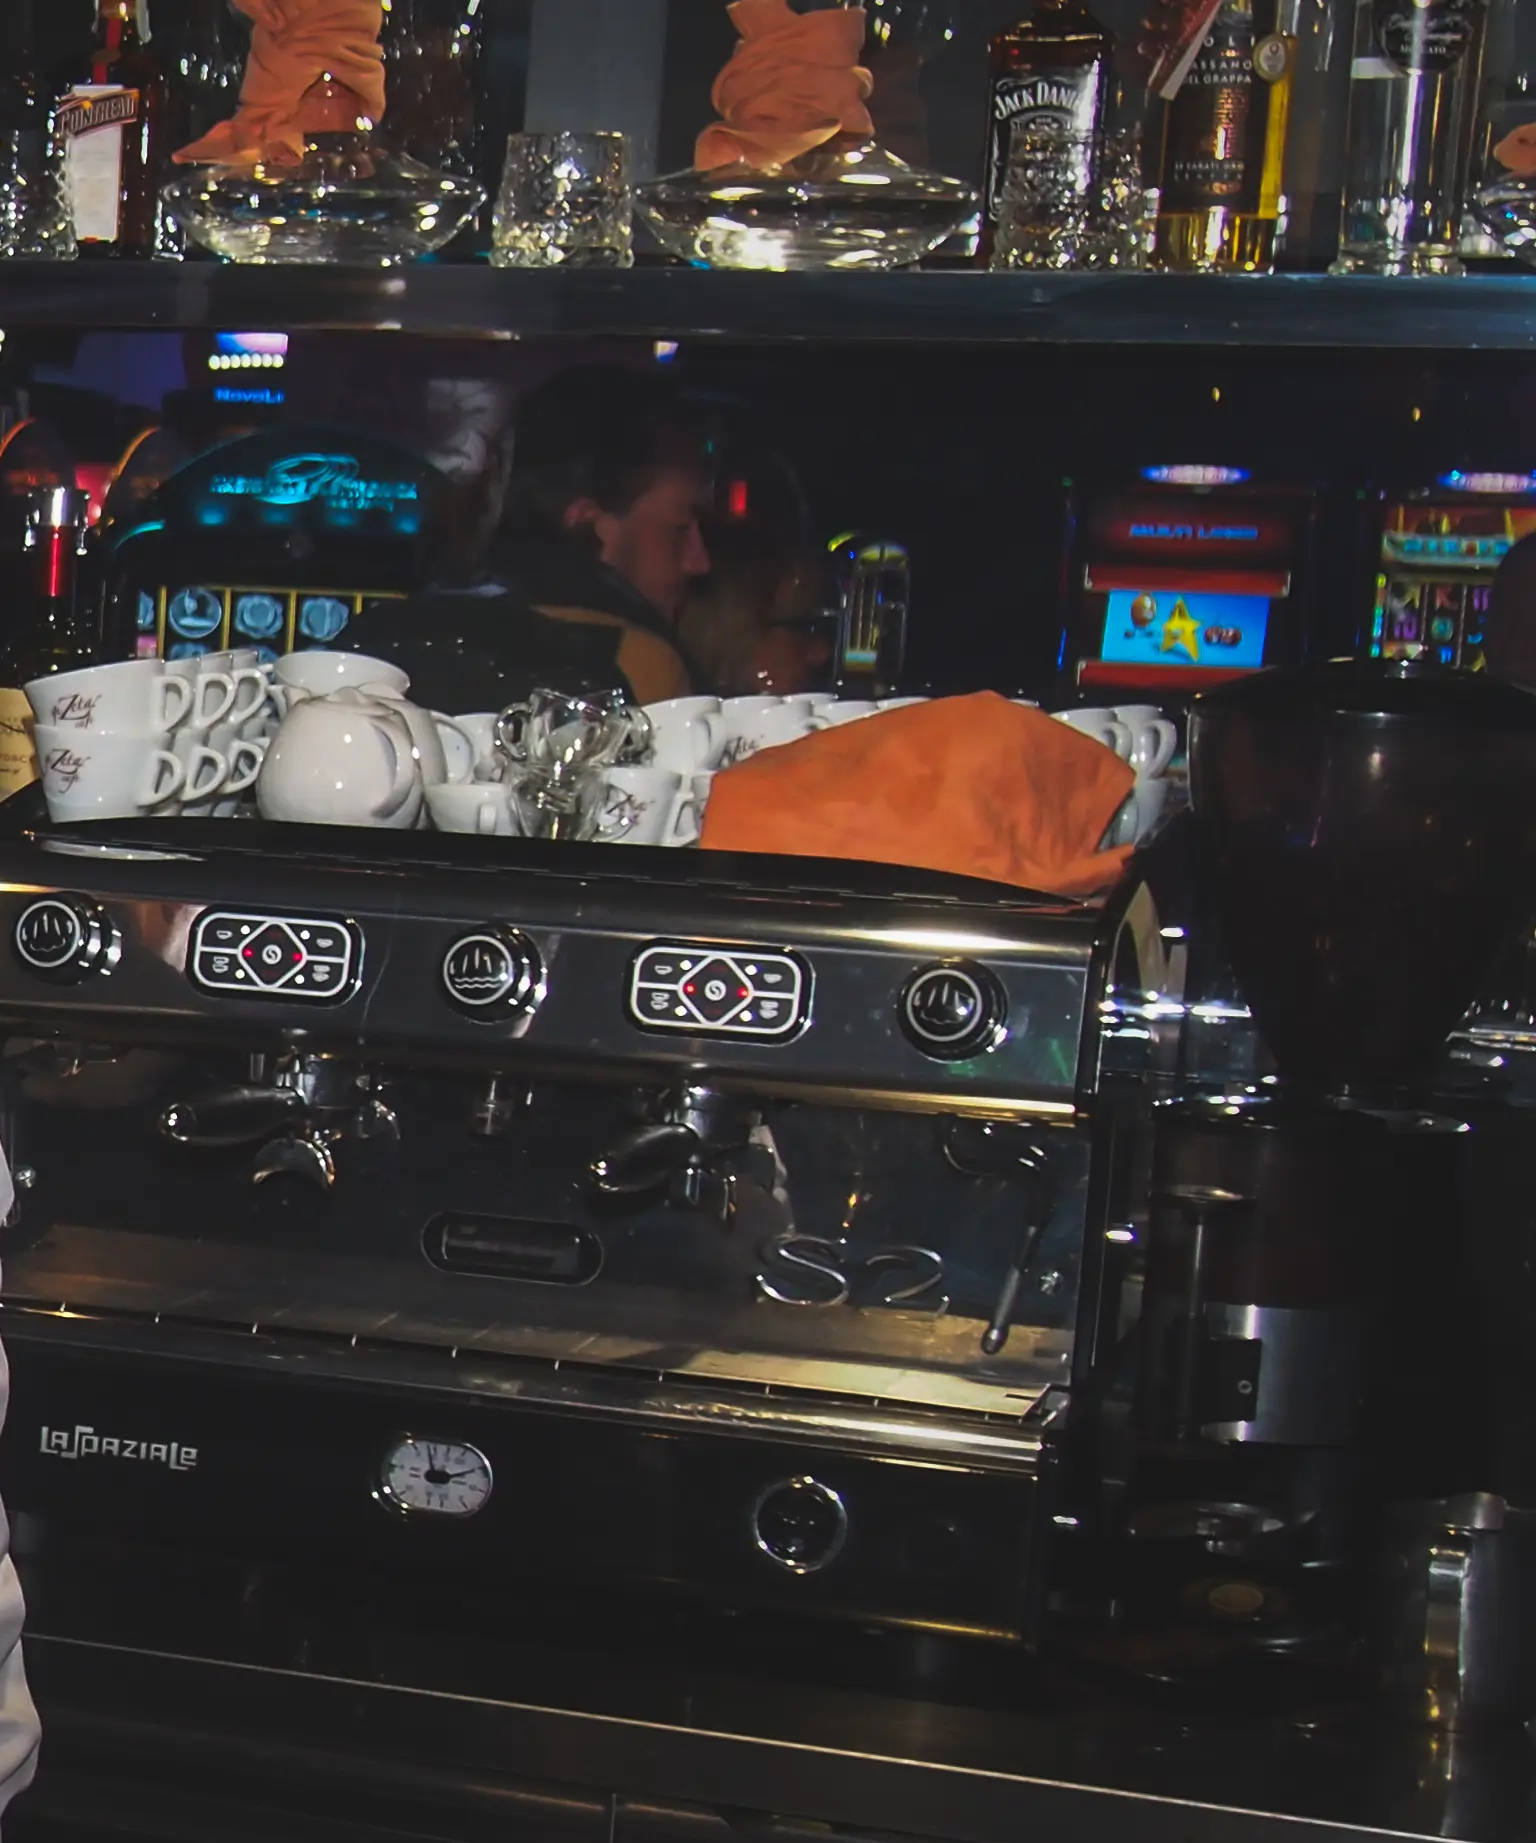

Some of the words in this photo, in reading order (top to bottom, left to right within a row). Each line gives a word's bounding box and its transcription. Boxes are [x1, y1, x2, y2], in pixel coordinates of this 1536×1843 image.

[1203, 35, 1256, 47] OLI
[1192, 58, 1254, 70] ASSANO
[1203, 73, 1253, 85] GRAPPA
[994, 86, 1035, 120] JACK
